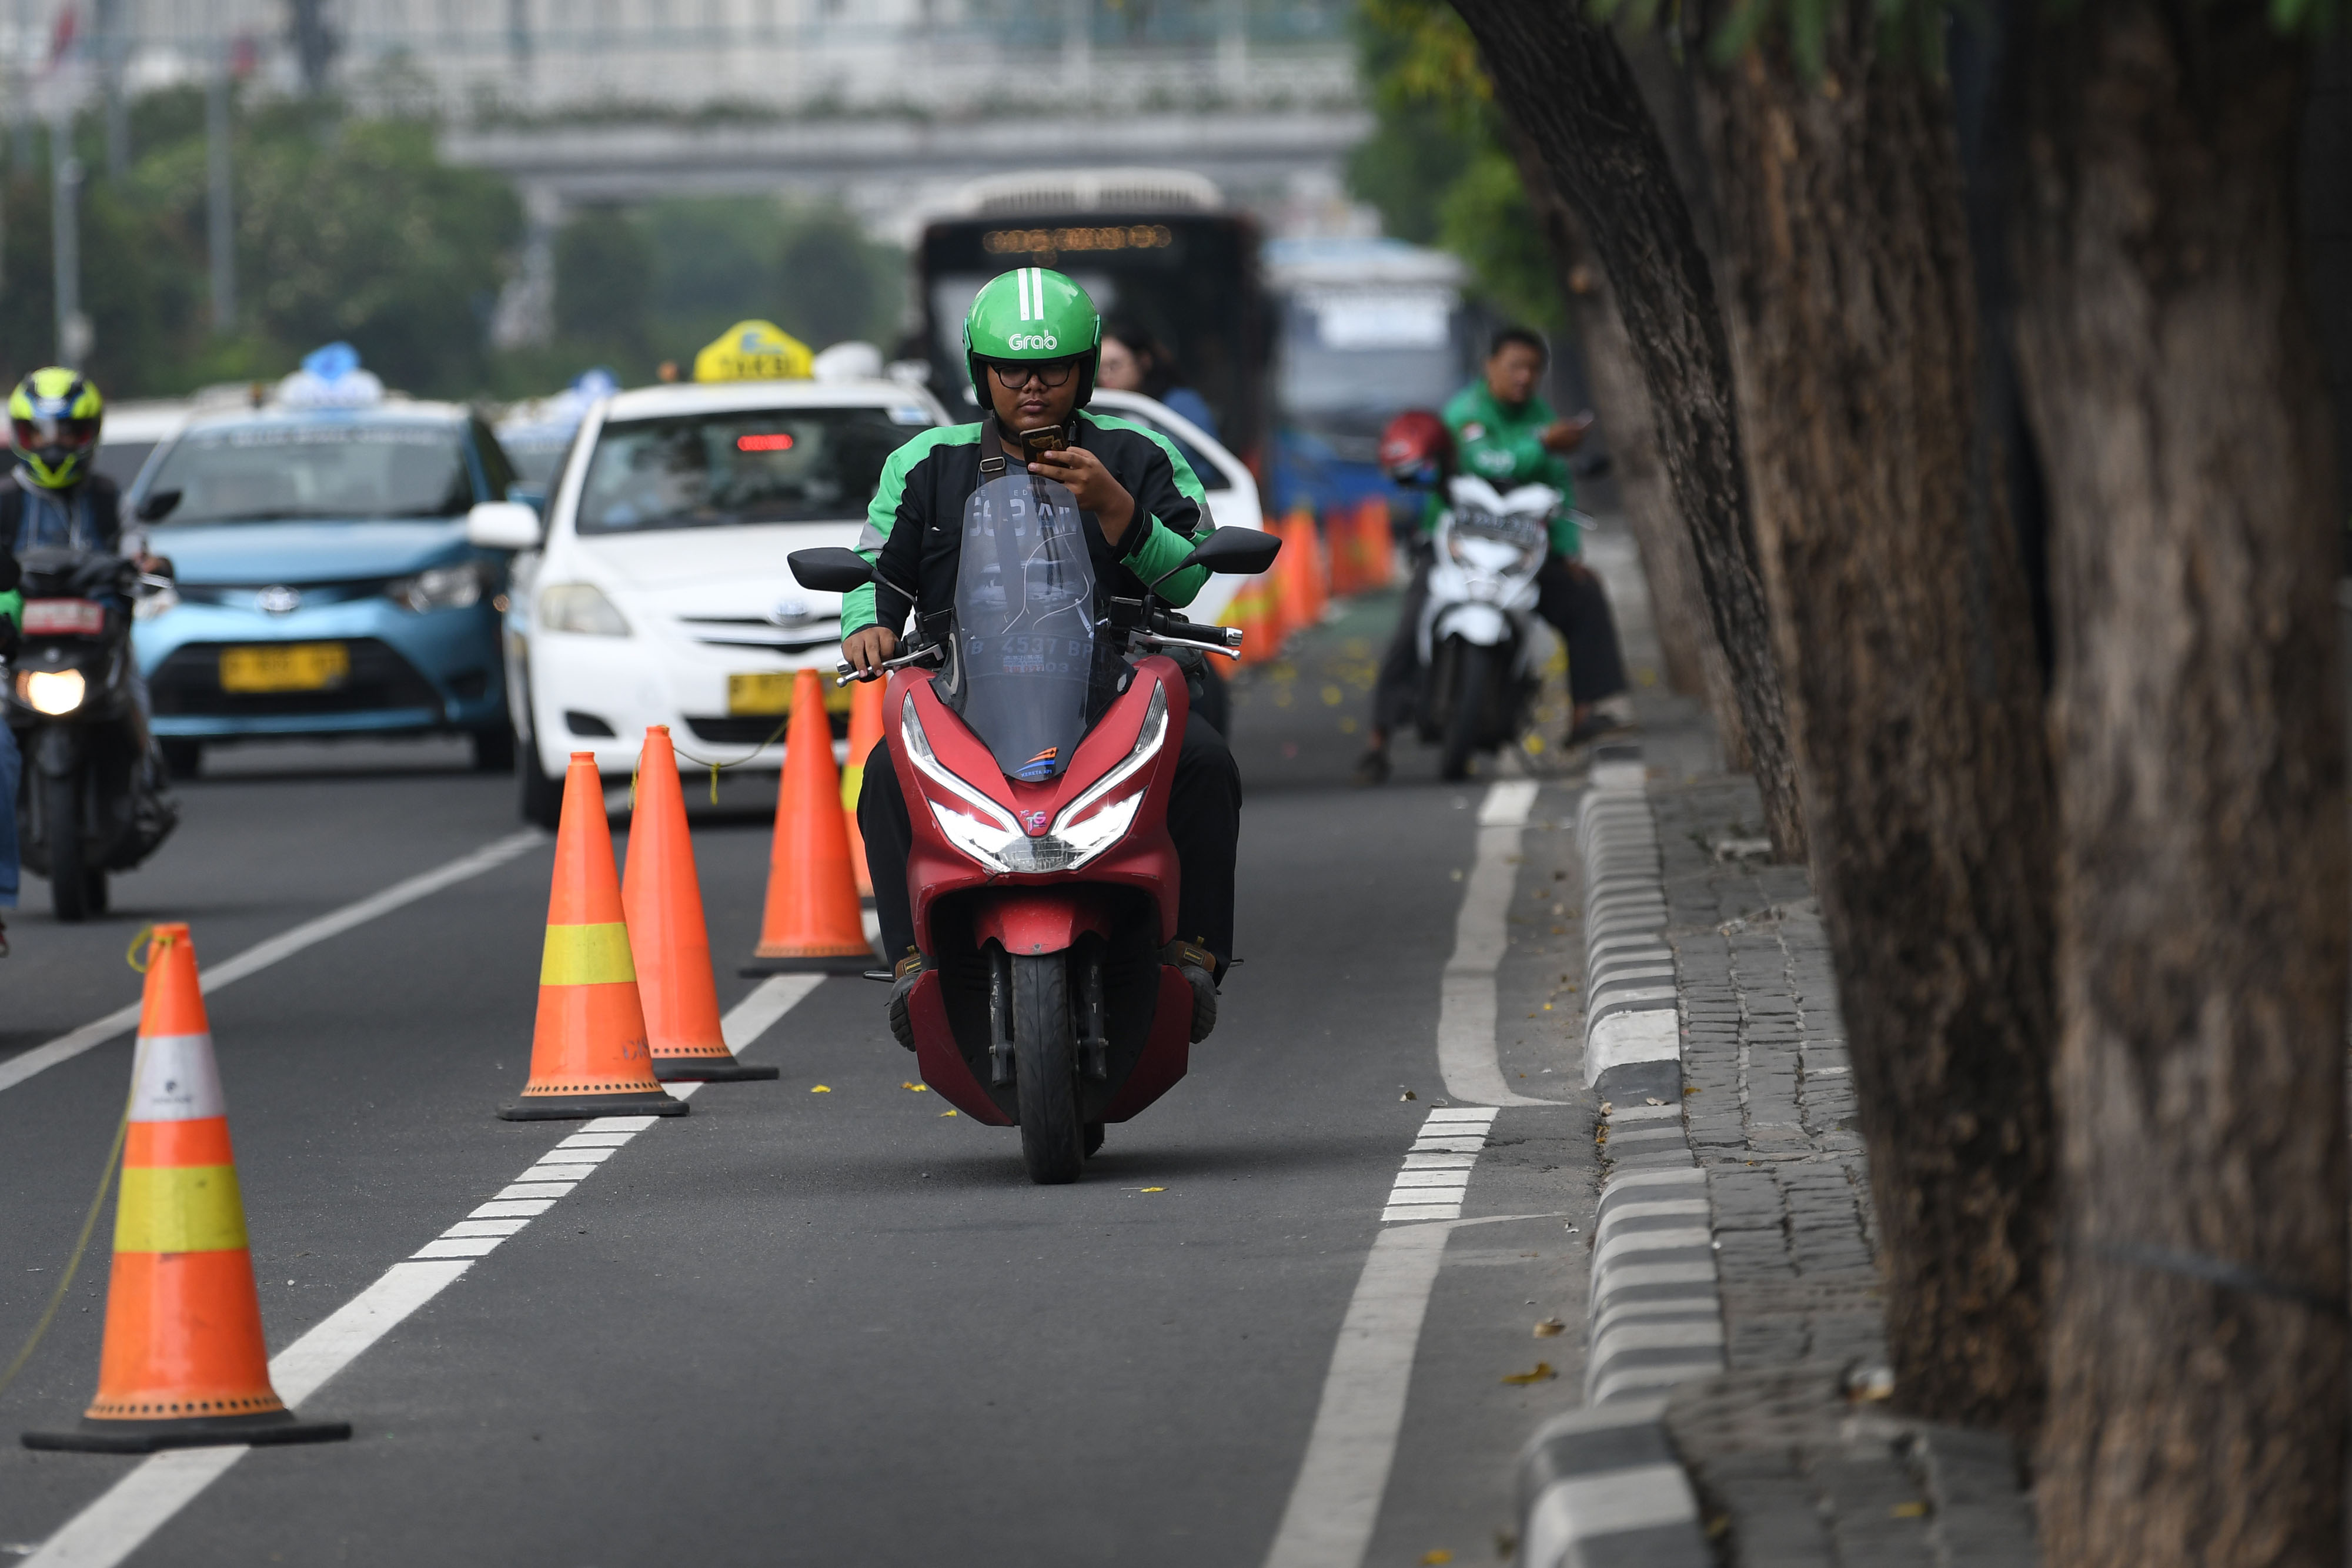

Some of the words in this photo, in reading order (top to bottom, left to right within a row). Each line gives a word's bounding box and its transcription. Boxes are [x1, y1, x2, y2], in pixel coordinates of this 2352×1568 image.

[1008, 329, 1058, 351] Grab
[971, 640, 984, 656] B
[1001, 636, 1058, 655] 4537
